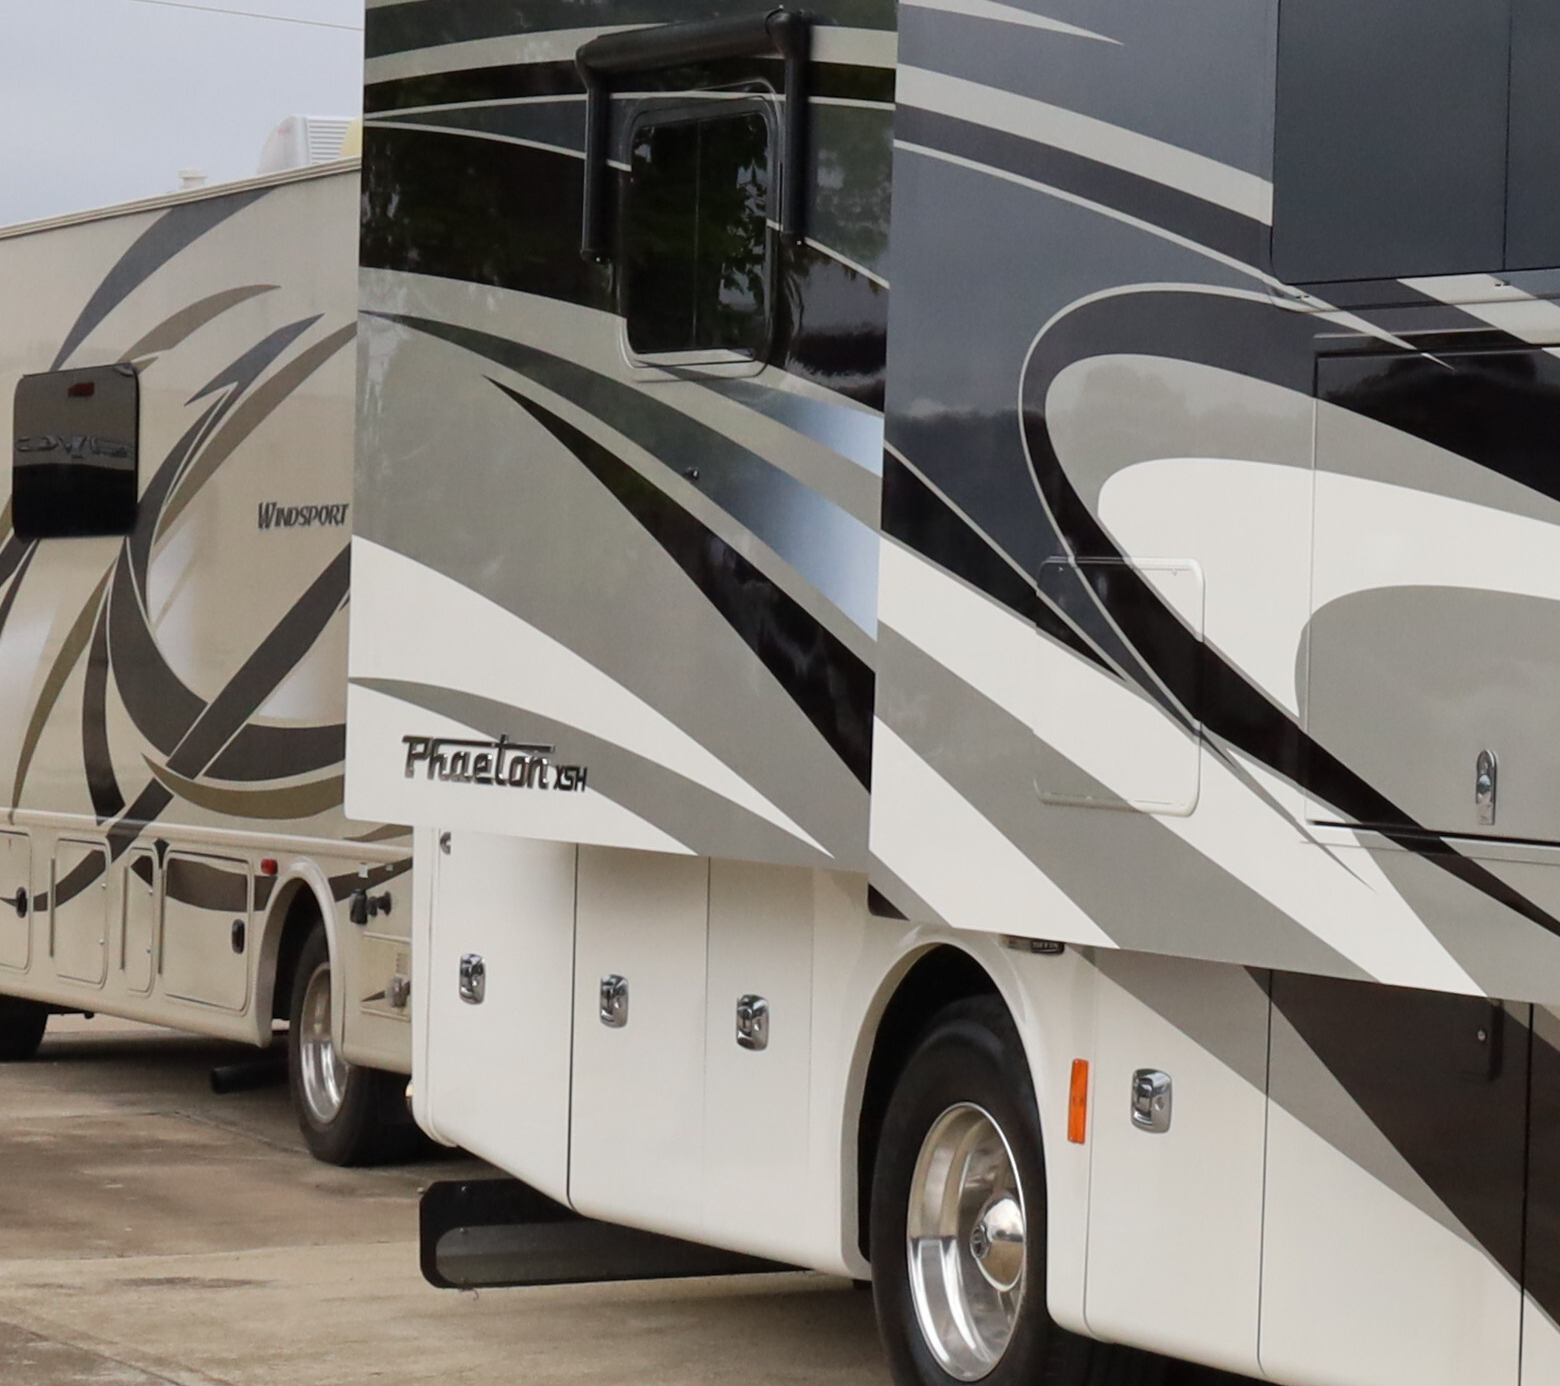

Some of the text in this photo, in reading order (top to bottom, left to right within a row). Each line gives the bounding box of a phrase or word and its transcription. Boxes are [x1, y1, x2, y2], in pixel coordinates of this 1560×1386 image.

[258, 502, 349, 530] WINDSPORT
[402, 734, 588, 792] Phaeton XSH
